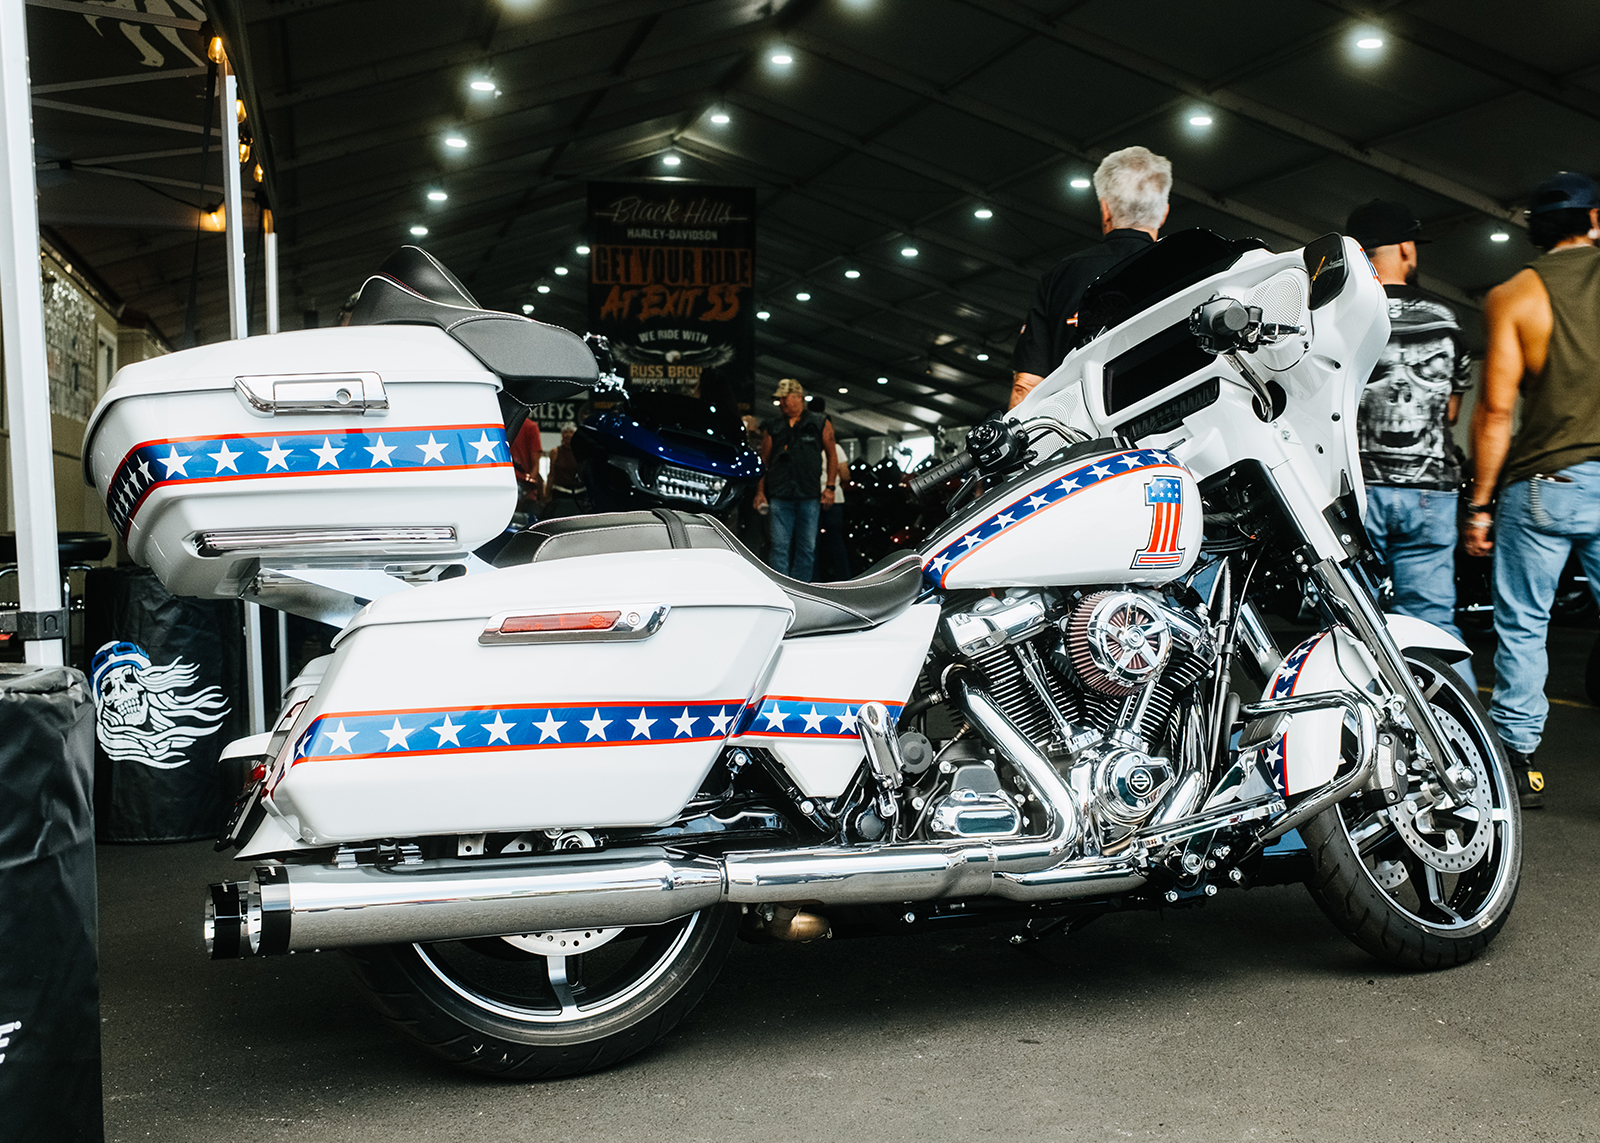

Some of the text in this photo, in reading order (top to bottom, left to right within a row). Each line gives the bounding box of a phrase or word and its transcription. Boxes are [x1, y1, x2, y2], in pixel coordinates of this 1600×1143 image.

[609, 194, 732, 224] Black Hills
[626, 228, 718, 241] HARLEY-DAVIDSON
[595, 247, 750, 284] GET YOUR RIDE
[698, 283, 743, 322] 55
[638, 329, 709, 344] WE RIDE WITH
[630, 363, 664, 377] RUSS
[1130, 475, 1186, 570] 1
